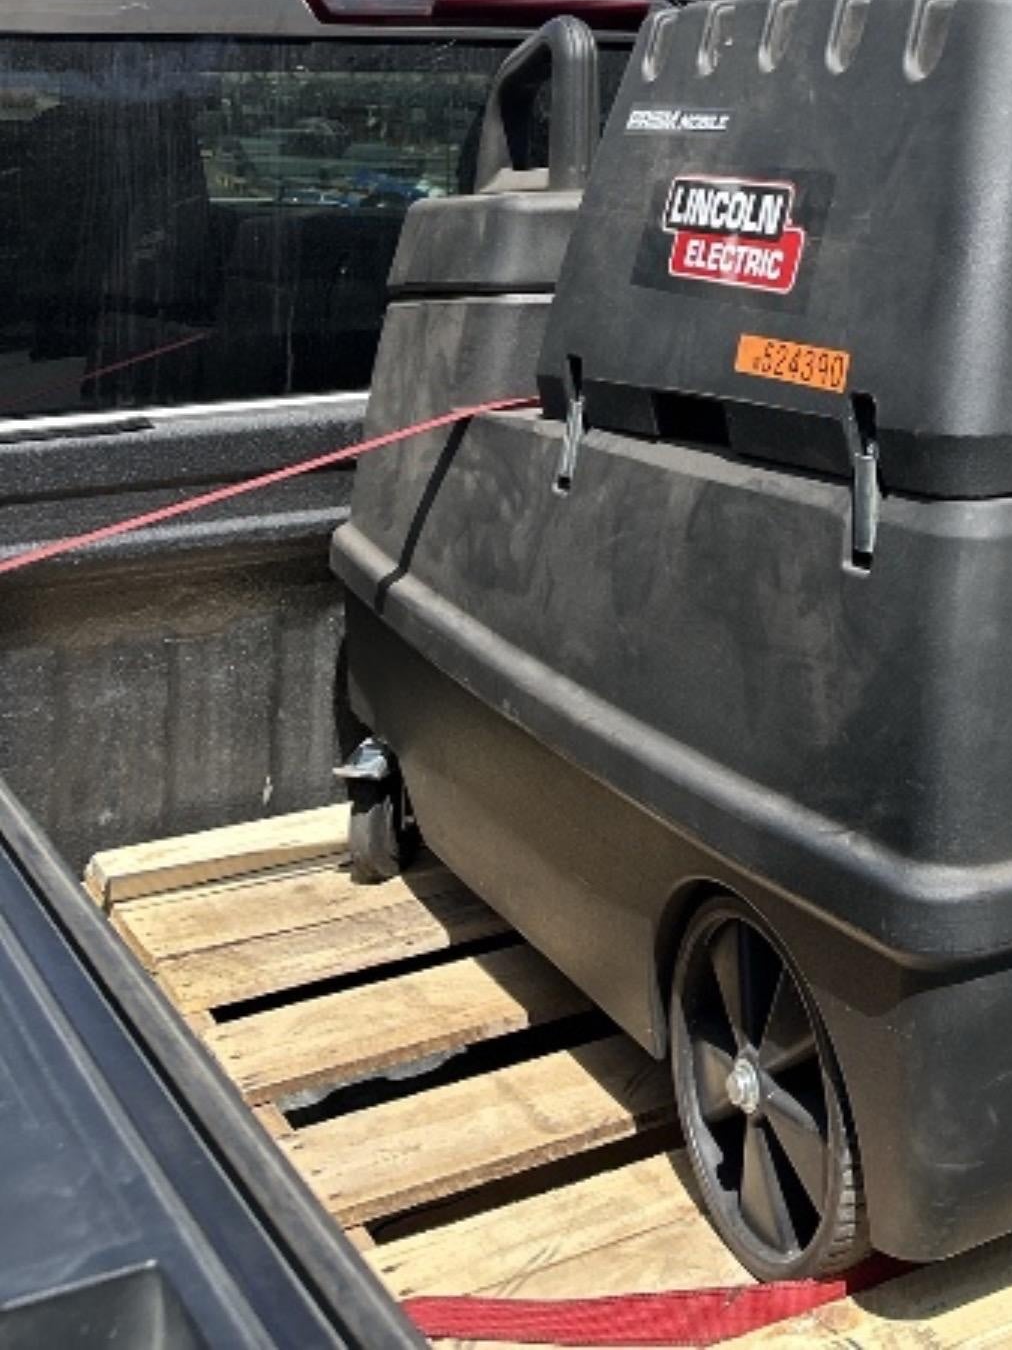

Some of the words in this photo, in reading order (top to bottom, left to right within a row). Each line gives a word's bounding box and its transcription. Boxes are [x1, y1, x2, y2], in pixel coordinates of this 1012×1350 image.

[668, 186, 784, 236] LINCOLN
[683, 239, 785, 281] ELECTRIC
[761, 341, 844, 388] 524390
